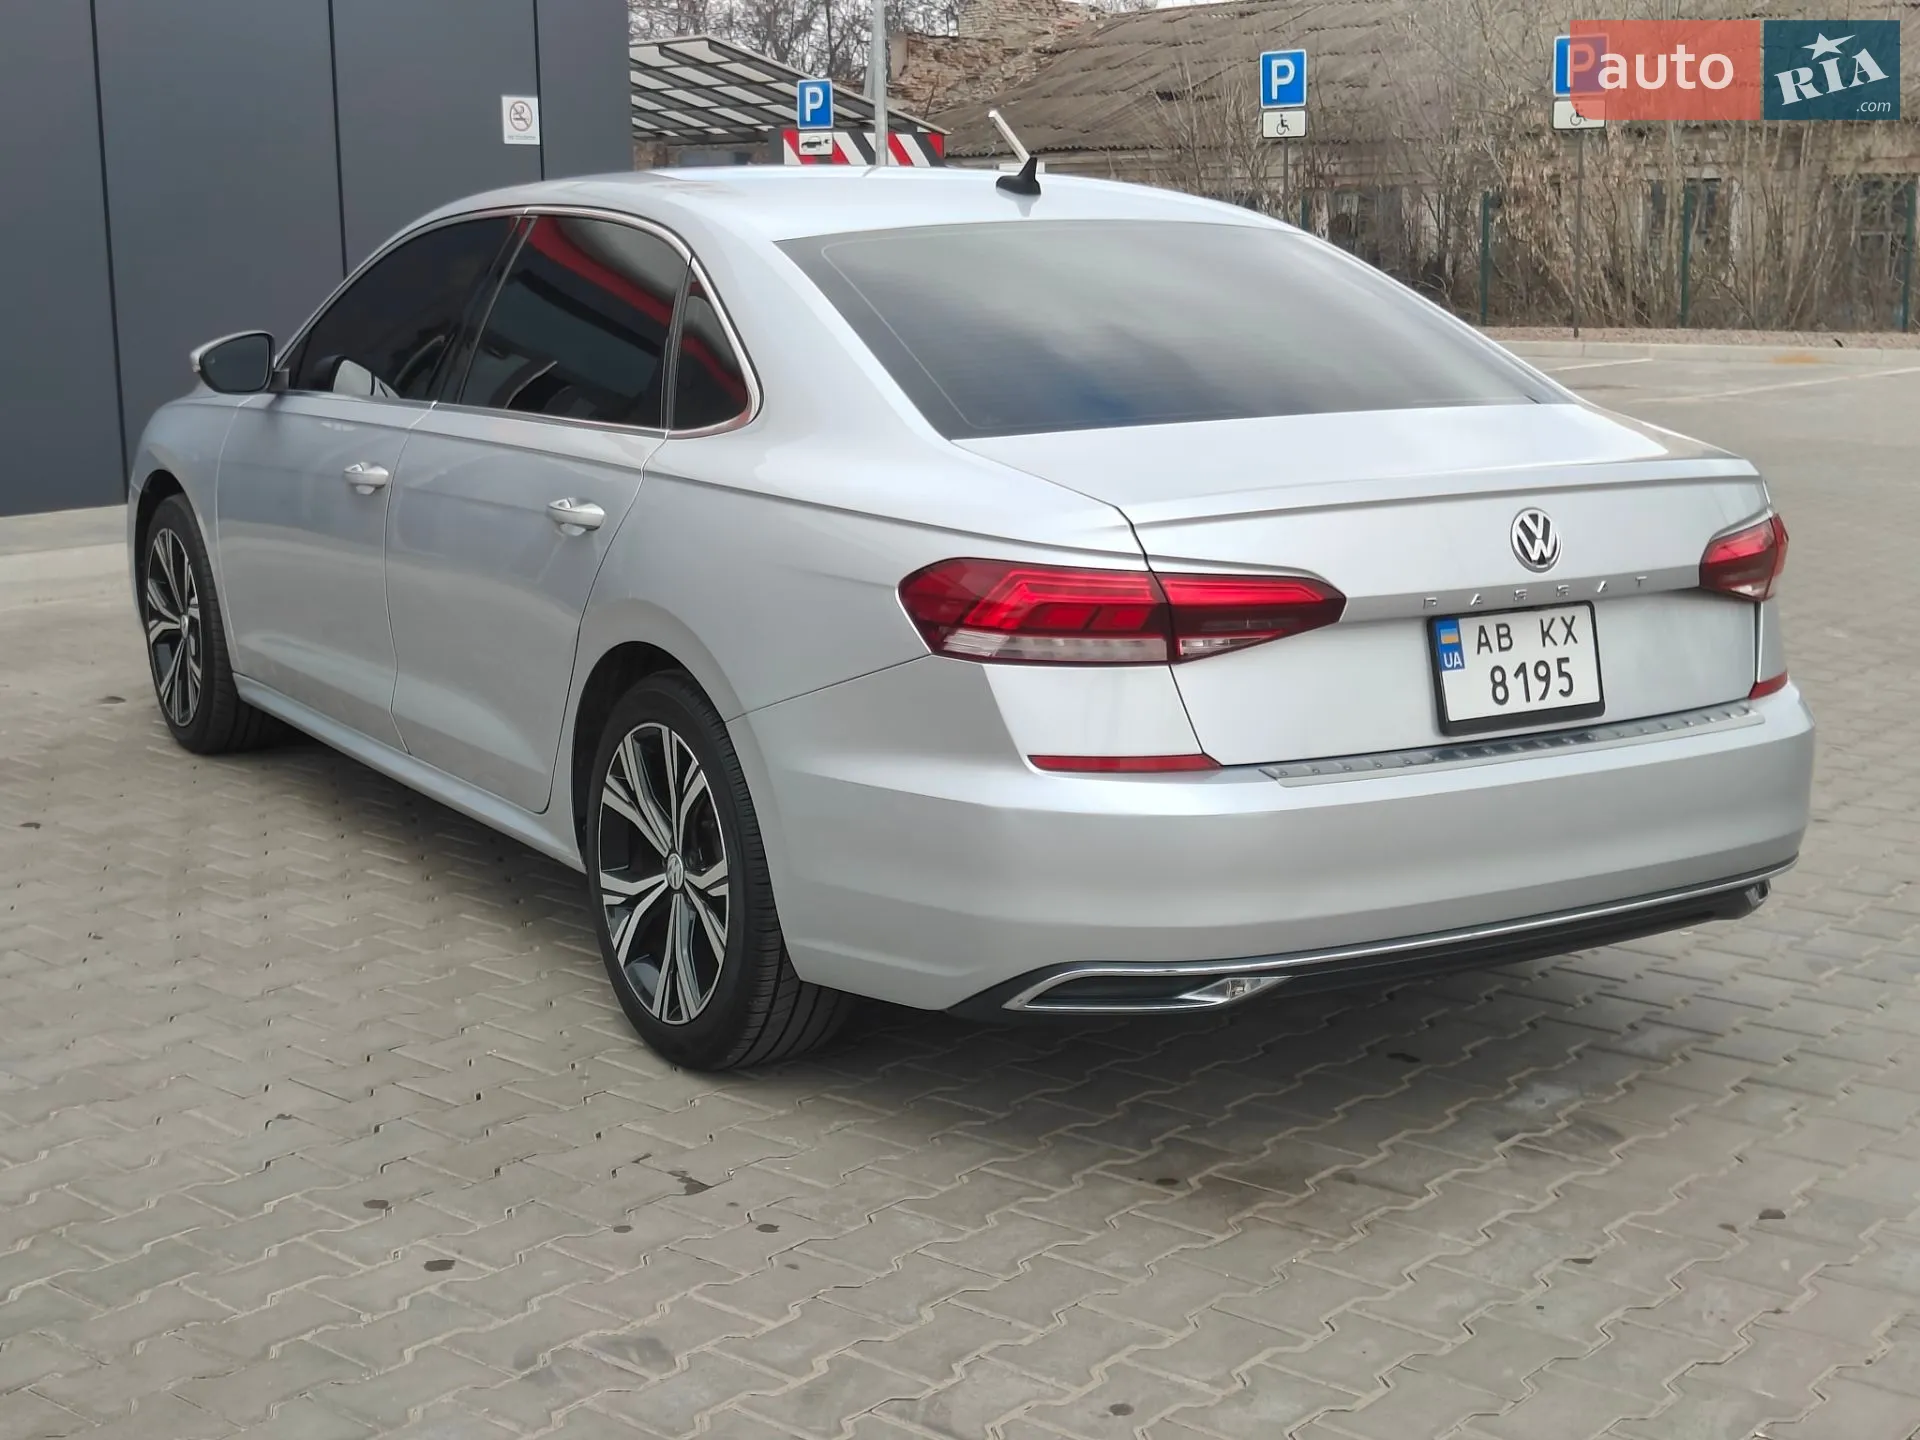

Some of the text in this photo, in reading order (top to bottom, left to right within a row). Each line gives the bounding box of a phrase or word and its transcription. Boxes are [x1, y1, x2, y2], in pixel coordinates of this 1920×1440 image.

[1271, 59, 1295, 100] P
[1566, 43, 1596, 88] P
[805, 86, 824, 122] P
[1476, 615, 1578, 655] AB KX
[1443, 652, 1463, 668] UA
[1490, 656, 1574, 706] 8195
